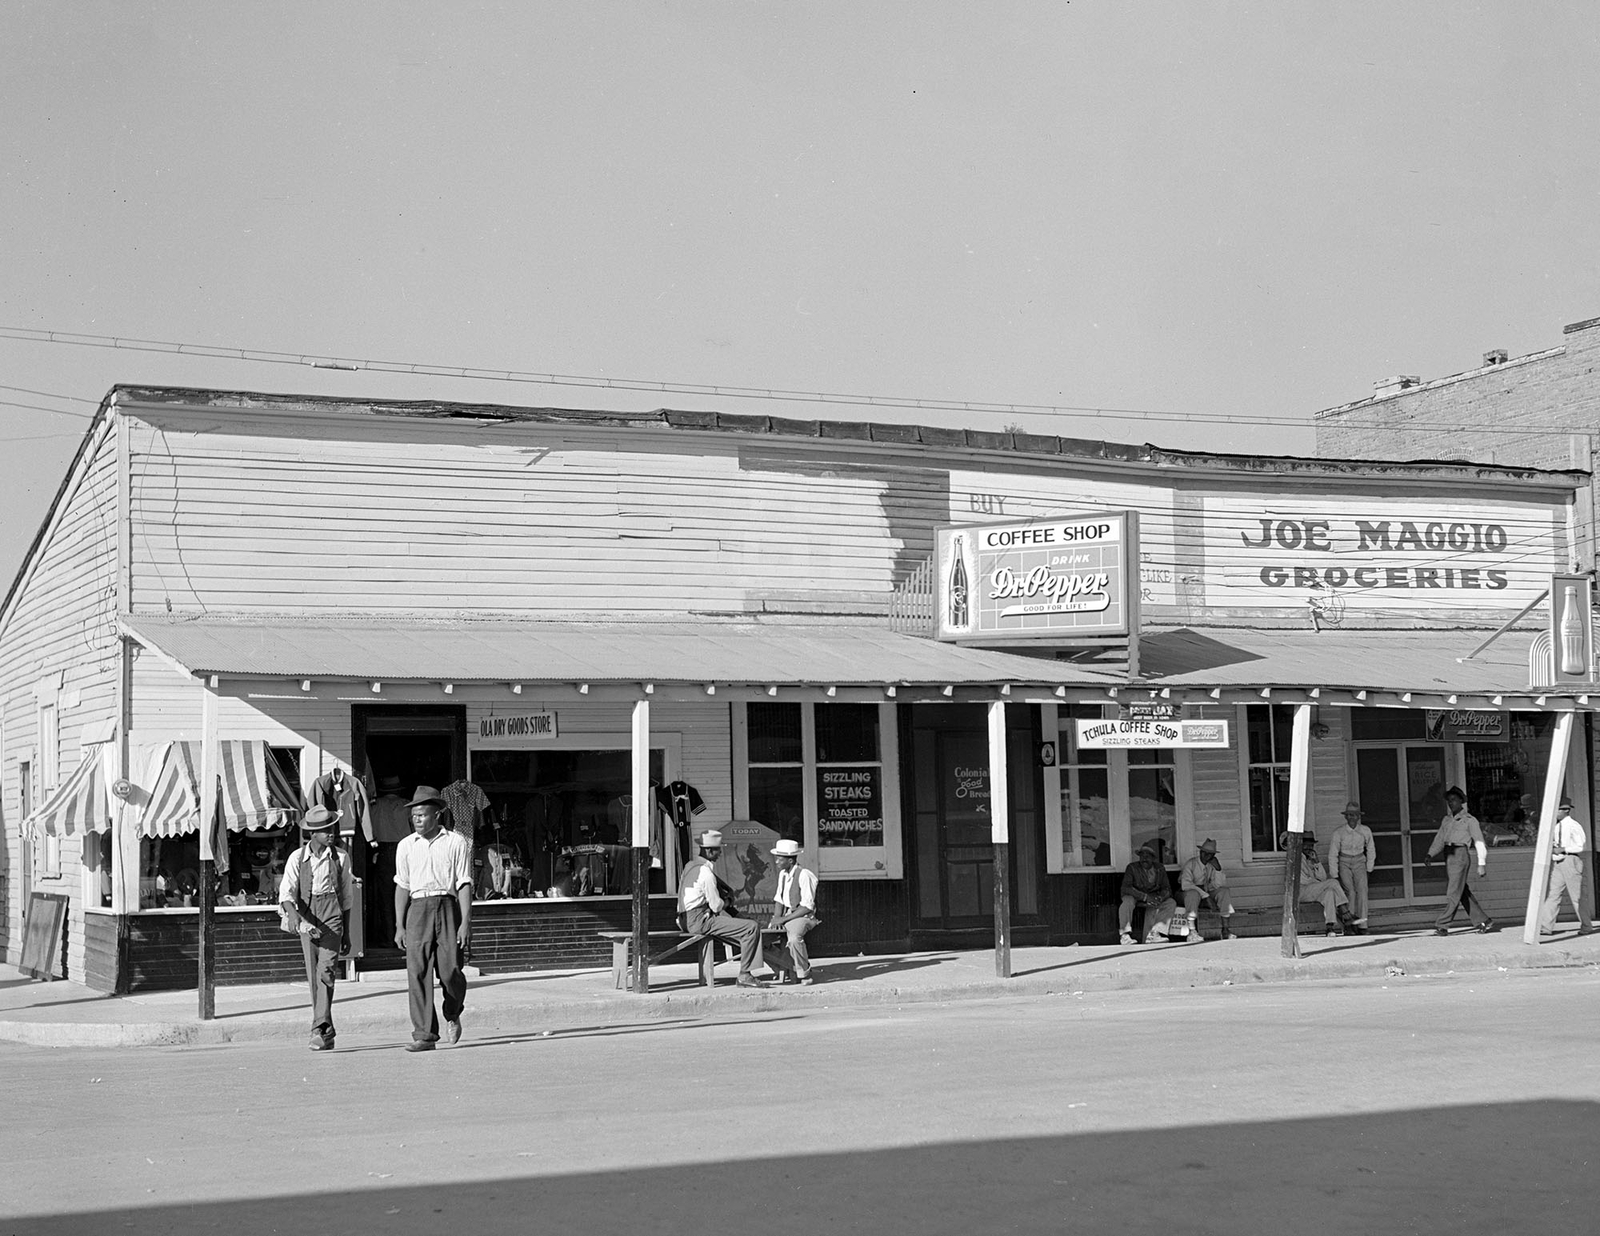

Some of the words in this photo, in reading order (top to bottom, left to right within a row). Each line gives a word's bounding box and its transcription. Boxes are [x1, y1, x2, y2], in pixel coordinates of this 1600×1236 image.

[970, 494, 1006, 515] BUY
[987, 527, 1055, 547] COFFEE
[1063, 524, 1110, 541] SHOP
[1240, 519, 1331, 551] JOE
[1355, 520, 1507, 552] MAGGIO
[1051, 554, 1090, 566] DRINK
[1259, 566, 1508, 590] GROCERIES
[480, 720, 493, 737] OLA
[494, 718, 506, 736] DRY
[507, 717, 529, 735] GOODS
[530, 715, 552, 733] STORE
[1082, 722, 1117, 741] TCHULA
[1120, 721, 1150, 734] COFFEE
[1154, 724, 1178, 741] SHOP
[823, 773, 872, 782] SIZZLING
[956, 777, 983, 798] good
[825, 786, 872, 799] STEAKS
[828, 808, 868, 817] TOASTED
[819, 818, 882, 831] SANDWICHES
